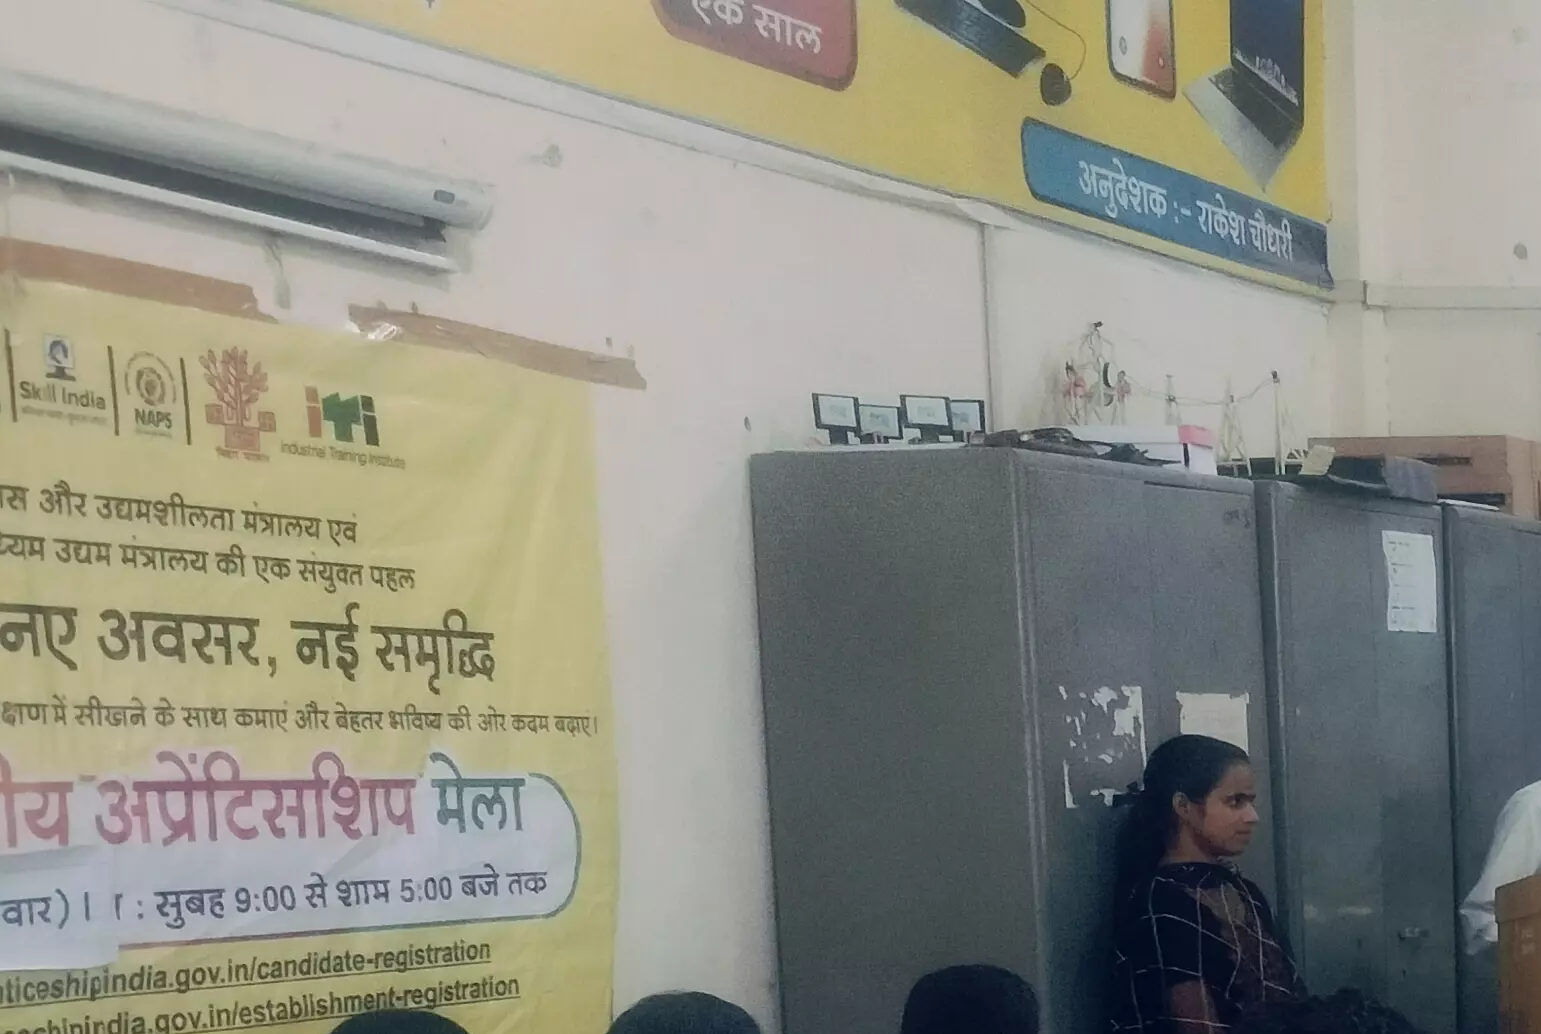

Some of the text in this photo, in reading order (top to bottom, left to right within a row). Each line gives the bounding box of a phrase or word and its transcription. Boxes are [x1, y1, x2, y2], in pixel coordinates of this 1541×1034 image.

[752, 4, 823, 54] साल
[1078, 157, 1294, 262] अनुदेशक राकेश चौधरी
[61, 388, 108, 411] India
[134, 407, 173, 430] NAPS
[40, 480, 358, 544] और उद्यमशीलता मंत्रालय एवं
[53, 537, 111, 568] उद्यम
[119, 534, 209, 575] मंत्रालय
[215, 543, 246, 579] की
[252, 555, 291, 583] एक
[370, 564, 415, 591] पहल
[1, 601, 496, 695] नए अवसर, नई समृद्धि
[74, 695, 550, 734] सीखने के साथ और बेहतर भविष्य की ओर कदम
[95, 750, 526, 847] अप्रेंटिसशिप मेला
[154, 863, 547, 930] सुबह 9:00 से शाम 5:00 बजे तक
